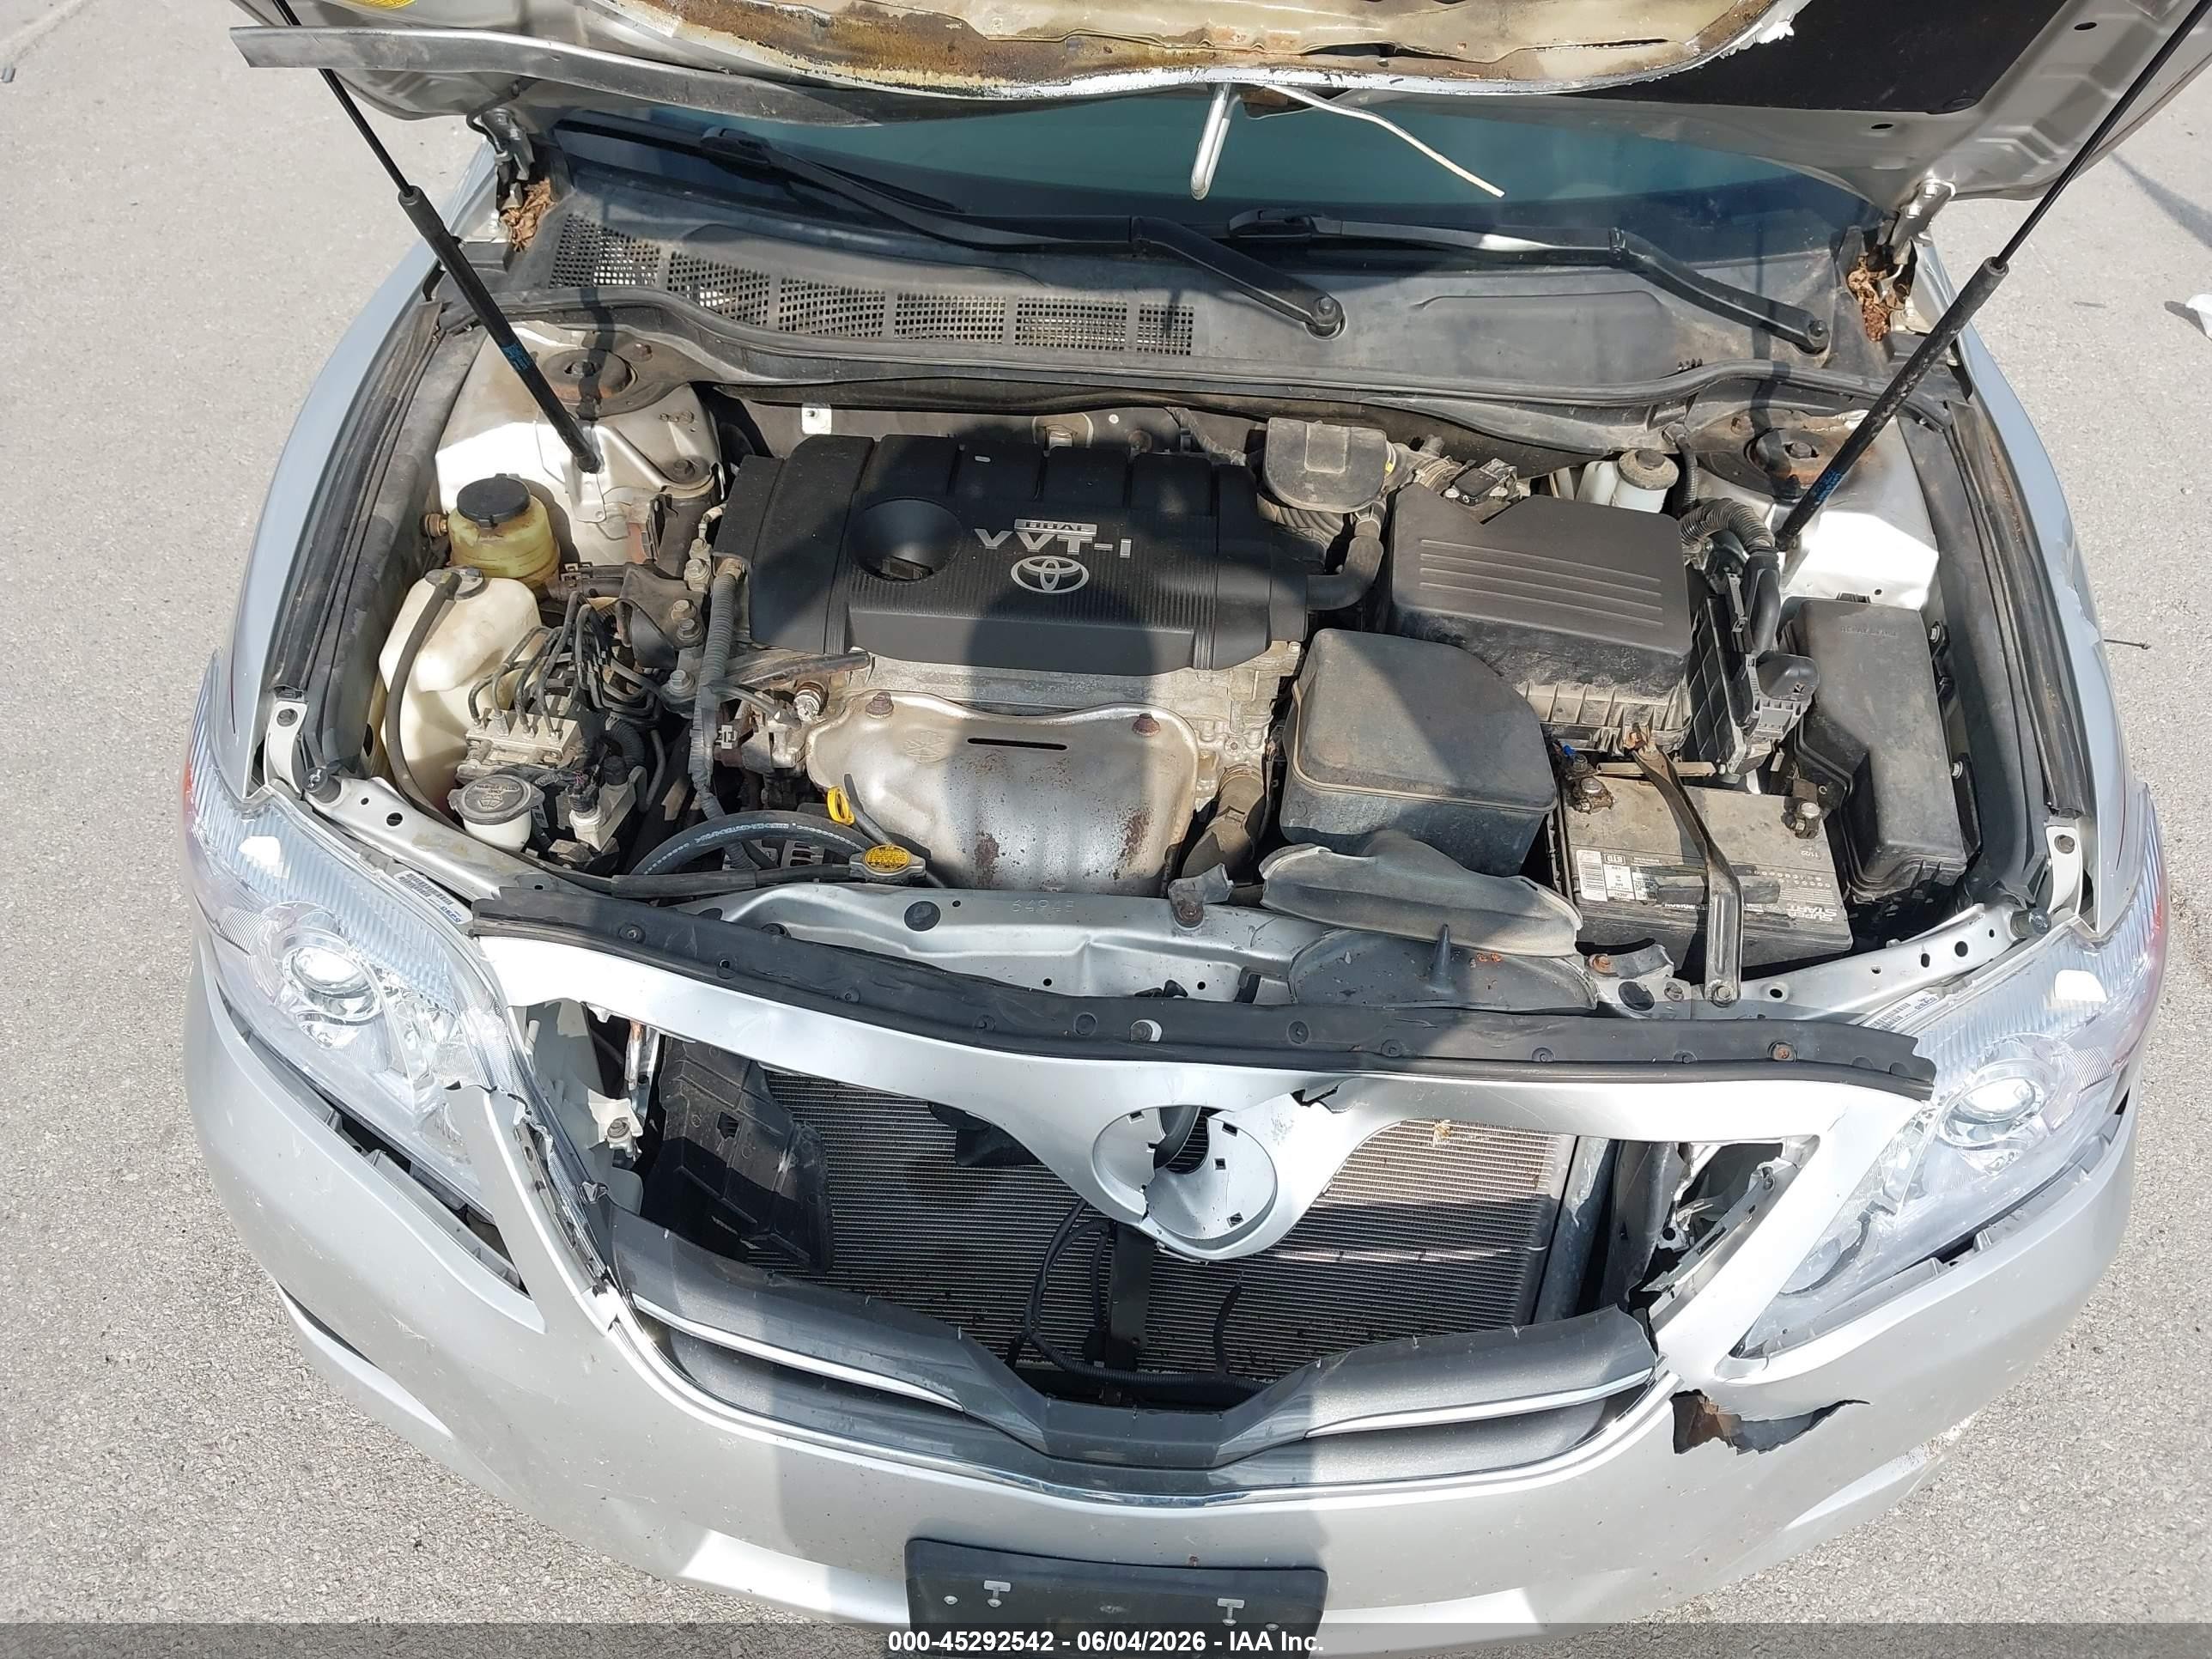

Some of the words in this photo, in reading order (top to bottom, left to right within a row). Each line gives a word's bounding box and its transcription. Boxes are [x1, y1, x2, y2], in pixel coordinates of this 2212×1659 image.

[1024, 520, 1092, 532] DUAL
[1785, 904, 1837, 916] START
[1786, 910, 1834, 922] SUPER
